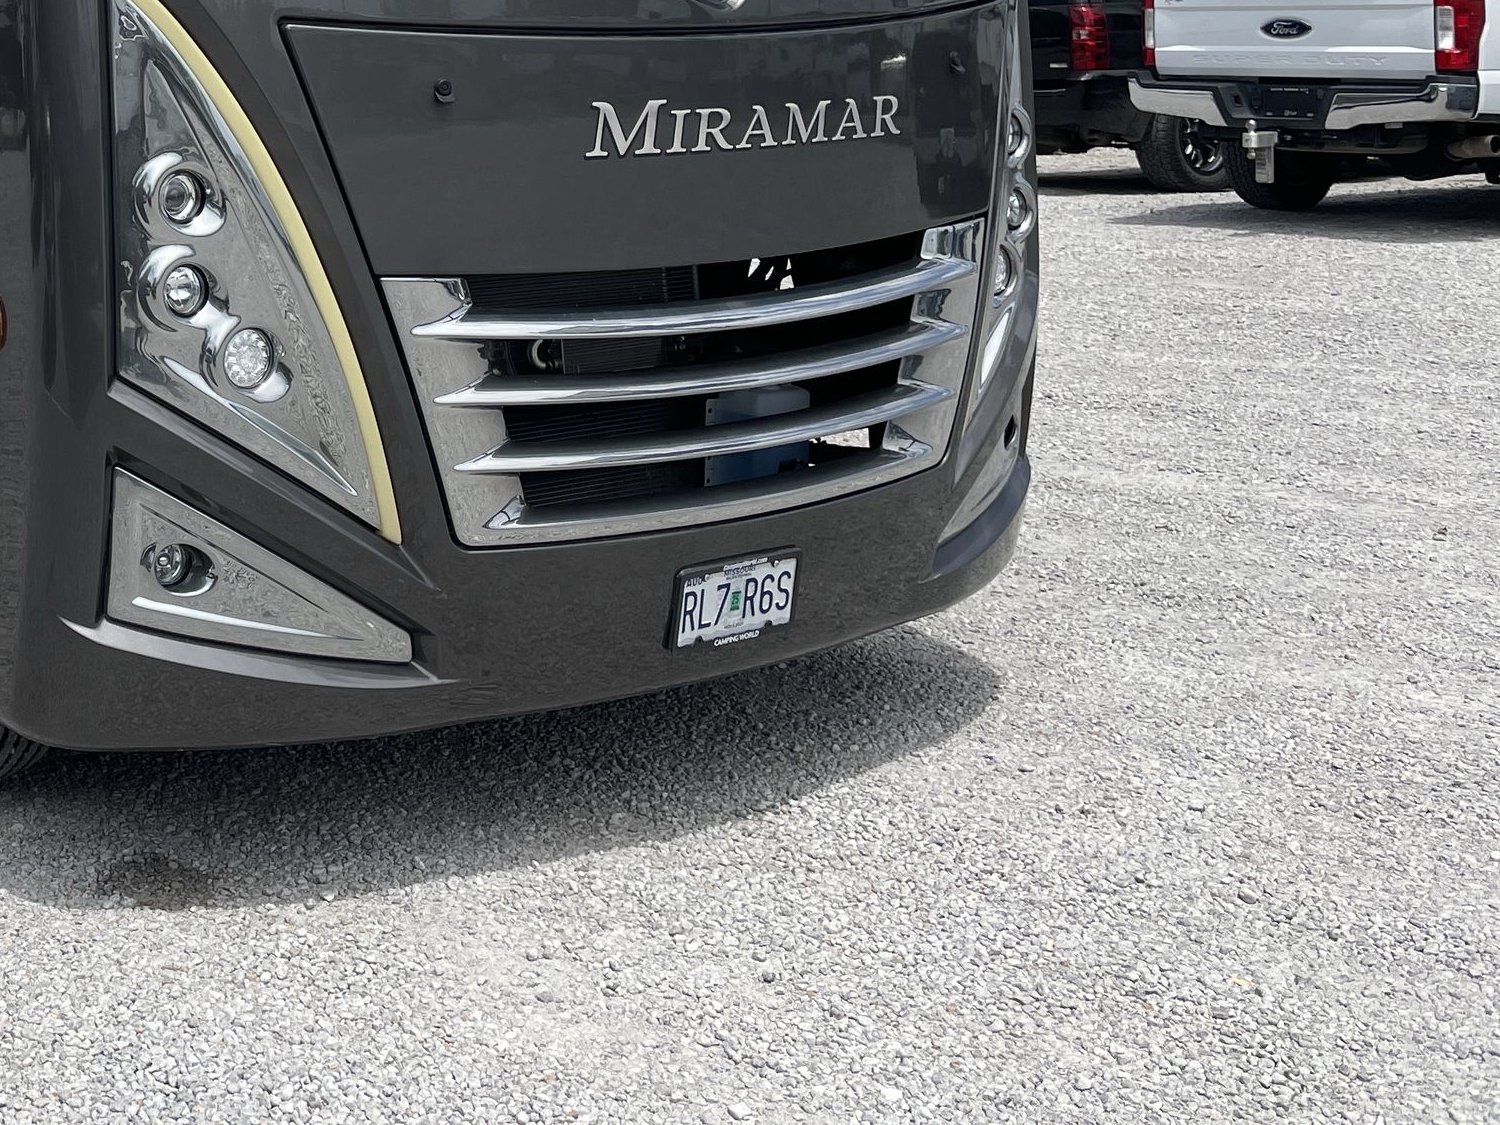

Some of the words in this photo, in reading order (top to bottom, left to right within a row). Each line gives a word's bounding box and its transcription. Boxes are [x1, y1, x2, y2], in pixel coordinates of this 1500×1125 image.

[1270, 21, 1299, 36] Ford
[1192, 54, 1293, 66] SUPER
[1303, 55, 1388, 67] DUTY
[584, 94, 901, 158] MIRAMAR
[682, 582, 731, 634] RL7
[742, 570, 792, 619] R6S
[713, 635, 739, 647] CAMPING
[739, 630, 760, 641] WORLD
